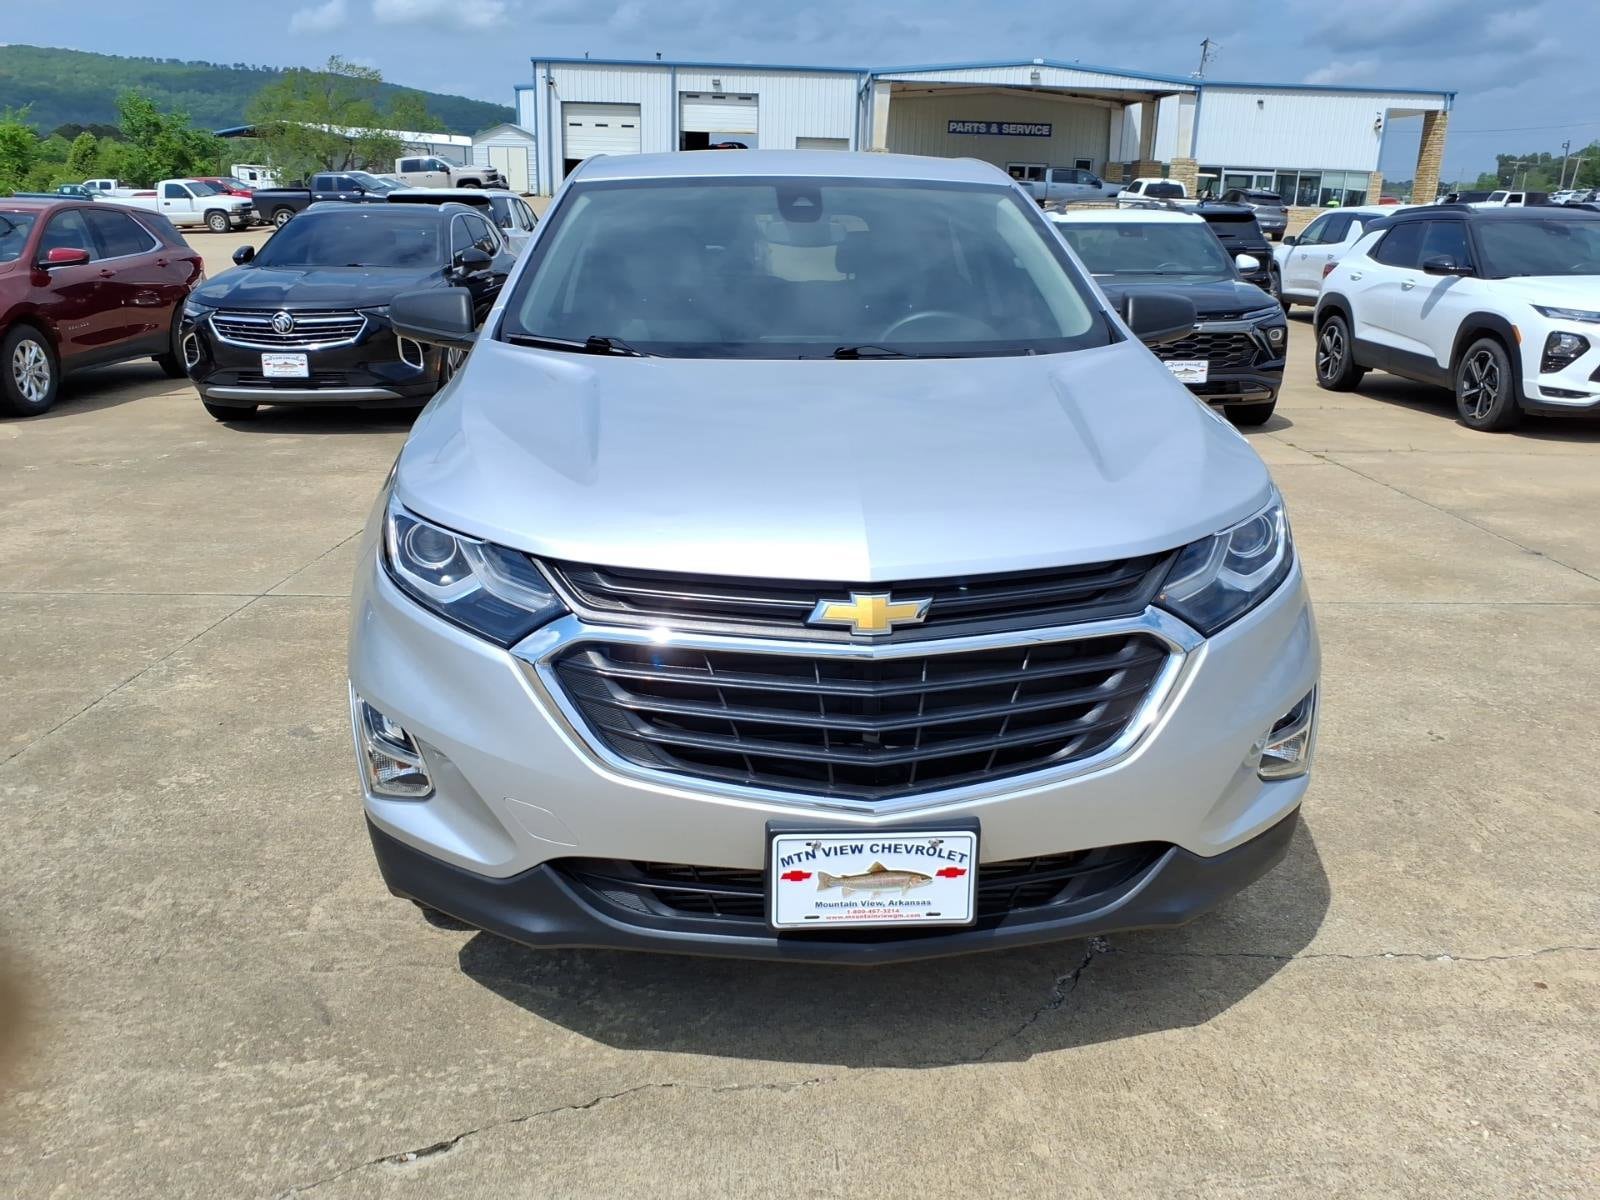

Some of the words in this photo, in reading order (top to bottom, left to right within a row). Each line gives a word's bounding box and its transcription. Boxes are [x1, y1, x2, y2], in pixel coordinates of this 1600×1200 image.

[949, 122, 986, 133] PARTS
[990, 123, 998, 133] &
[1002, 124, 1050, 135] SERVICE
[780, 850, 817, 868] MTN
[822, 844, 864, 857] VIEW
[869, 843, 968, 863] CHEVROLET
[815, 900, 858, 908] Mountain
[860, 900, 886, 908] View,
